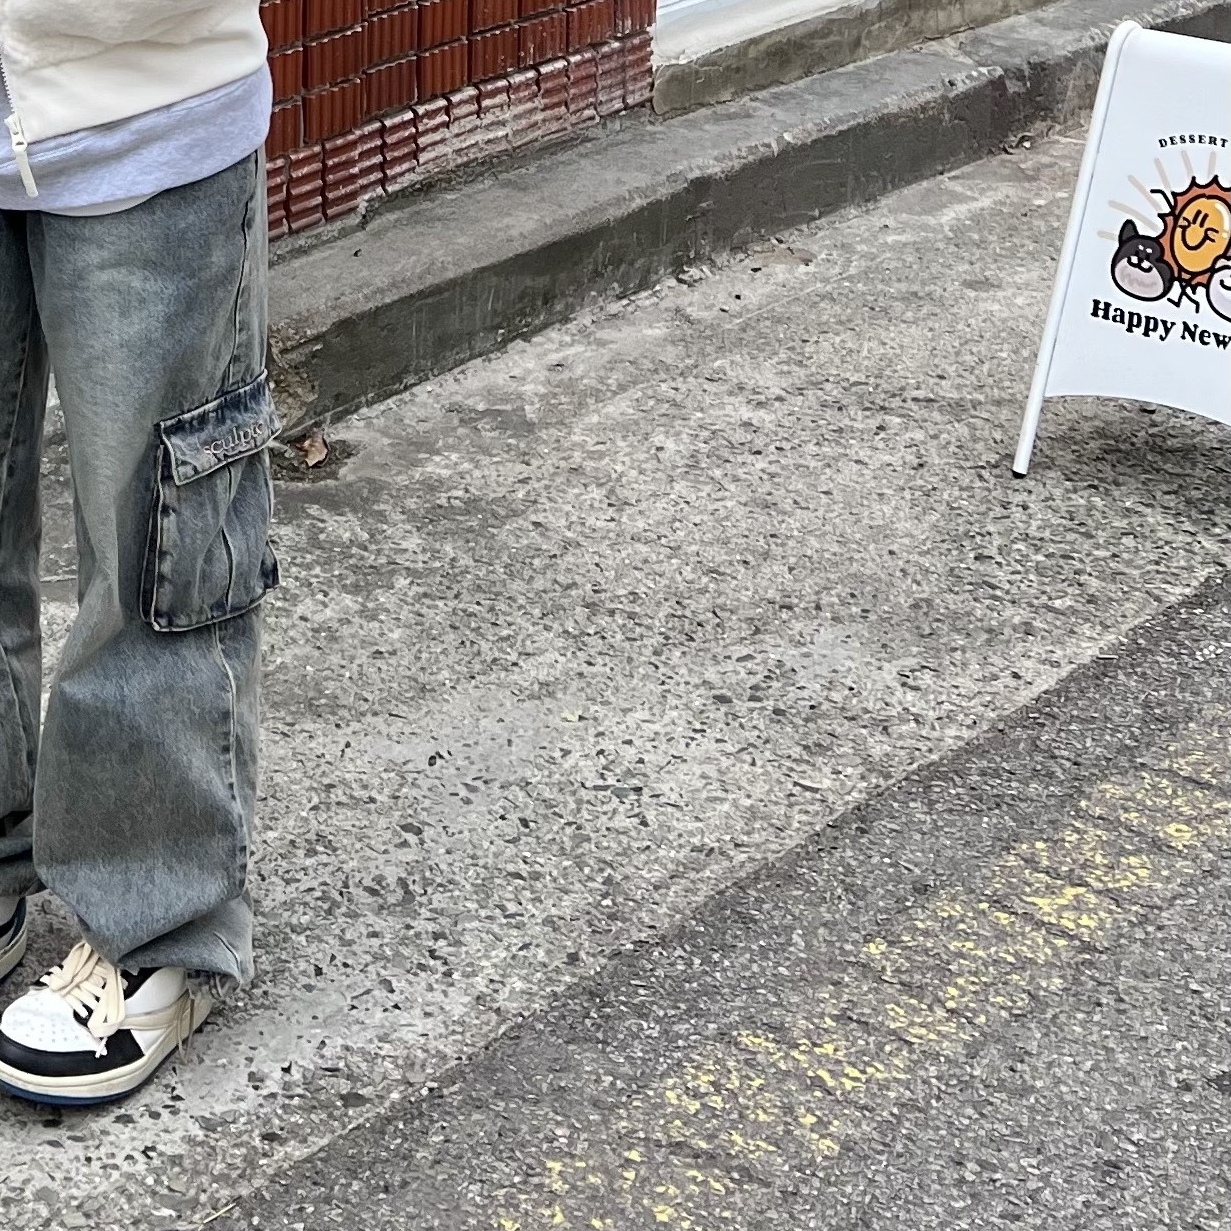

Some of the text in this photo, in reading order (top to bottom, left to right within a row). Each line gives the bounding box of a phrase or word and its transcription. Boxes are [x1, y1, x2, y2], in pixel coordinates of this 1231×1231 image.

[1158, 133, 1229, 148] DESSERT
[1090, 298, 1231, 350] Happy New
